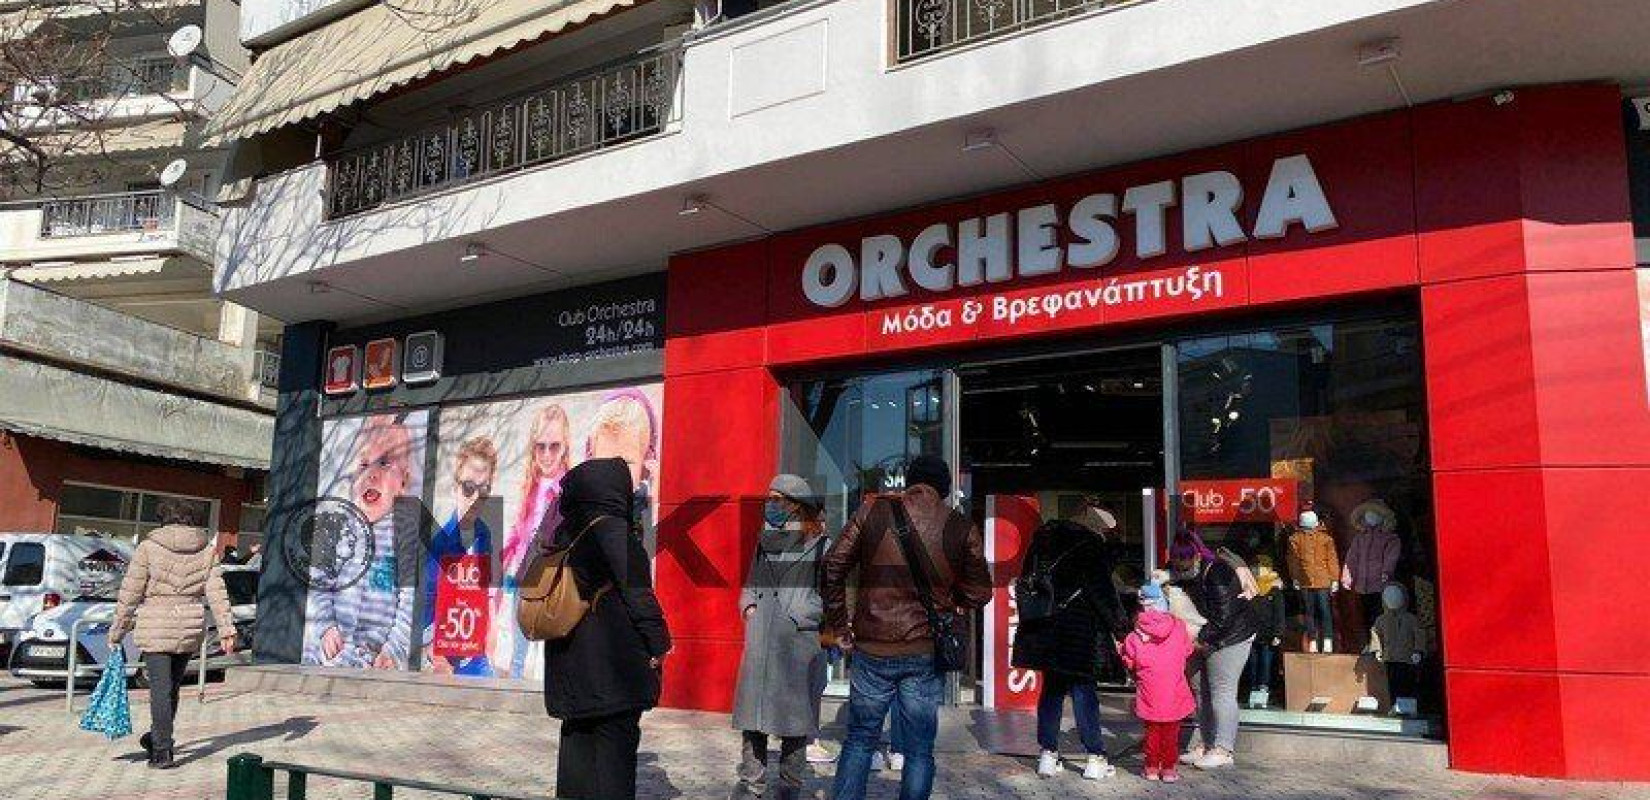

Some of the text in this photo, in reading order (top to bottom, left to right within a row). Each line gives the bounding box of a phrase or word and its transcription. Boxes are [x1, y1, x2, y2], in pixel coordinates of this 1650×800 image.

[802, 153, 1338, 308] ORCHESTRA
[559, 299, 655, 326] Club Orchestra
[882, 265, 1222, 335] Μόδα & Βρεφανάπτυξη
[1182, 488, 1224, 508] Club
[447, 562, 480, 585] Club
